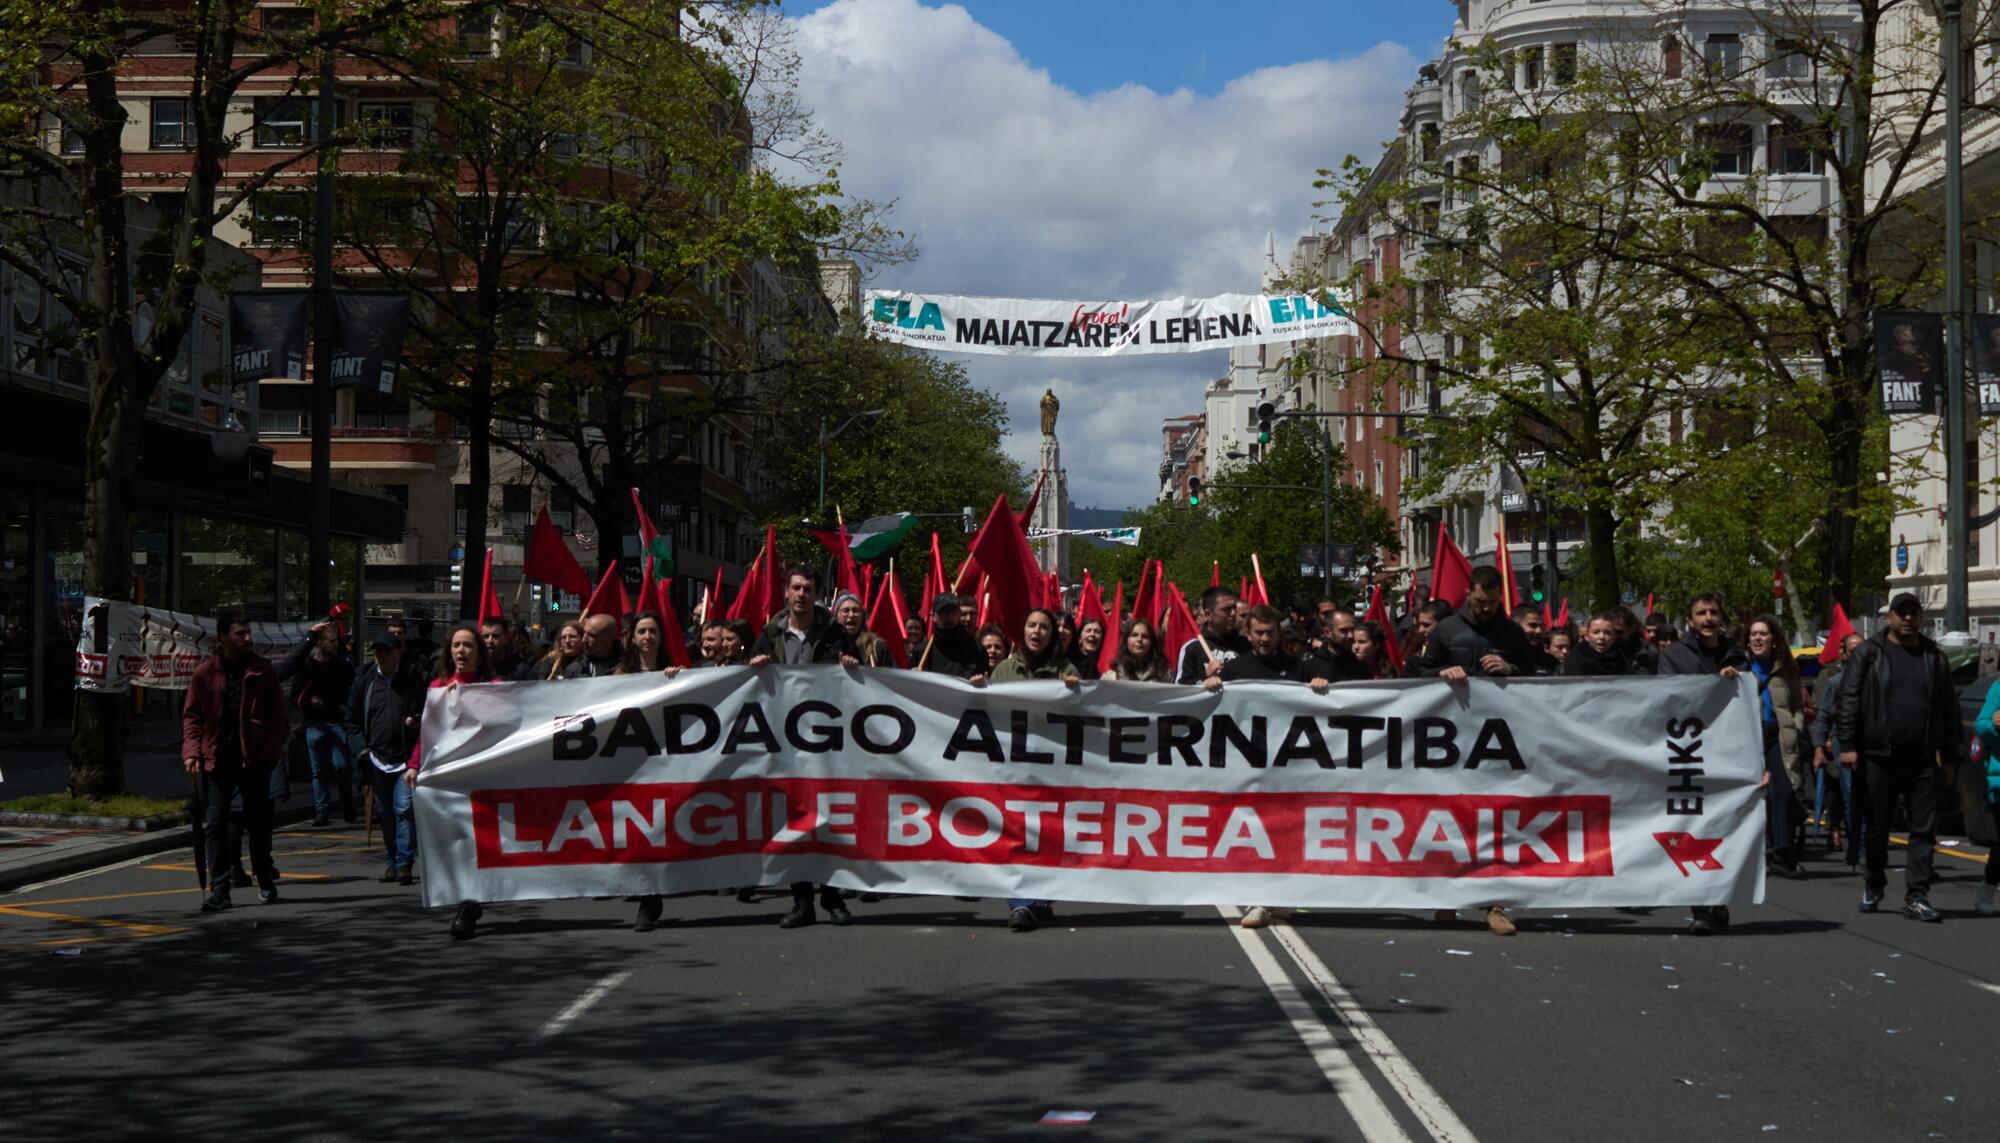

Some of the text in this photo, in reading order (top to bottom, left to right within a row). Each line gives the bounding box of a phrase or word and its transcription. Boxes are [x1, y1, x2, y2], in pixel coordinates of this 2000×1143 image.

[872, 297, 945, 331] ELA
[1072, 302, 1128, 332] Gora!
[1272, 320, 1349, 334] EUSKAL SINDIKATUA
[901, 330, 946, 342] SINDIKATUA
[955, 315, 1261, 347] MAIATZAREN LEHENA
[234, 349, 272, 374] FANT
[330, 356, 368, 380] FANT
[1882, 381, 1922, 402] FANT
[552, 699, 1526, 771] BADAGO ALTERNATIBA
[1666, 714, 1705, 818] EHKS
[496, 791, 1587, 864] LANGILE BOTEREA ERAIKI
